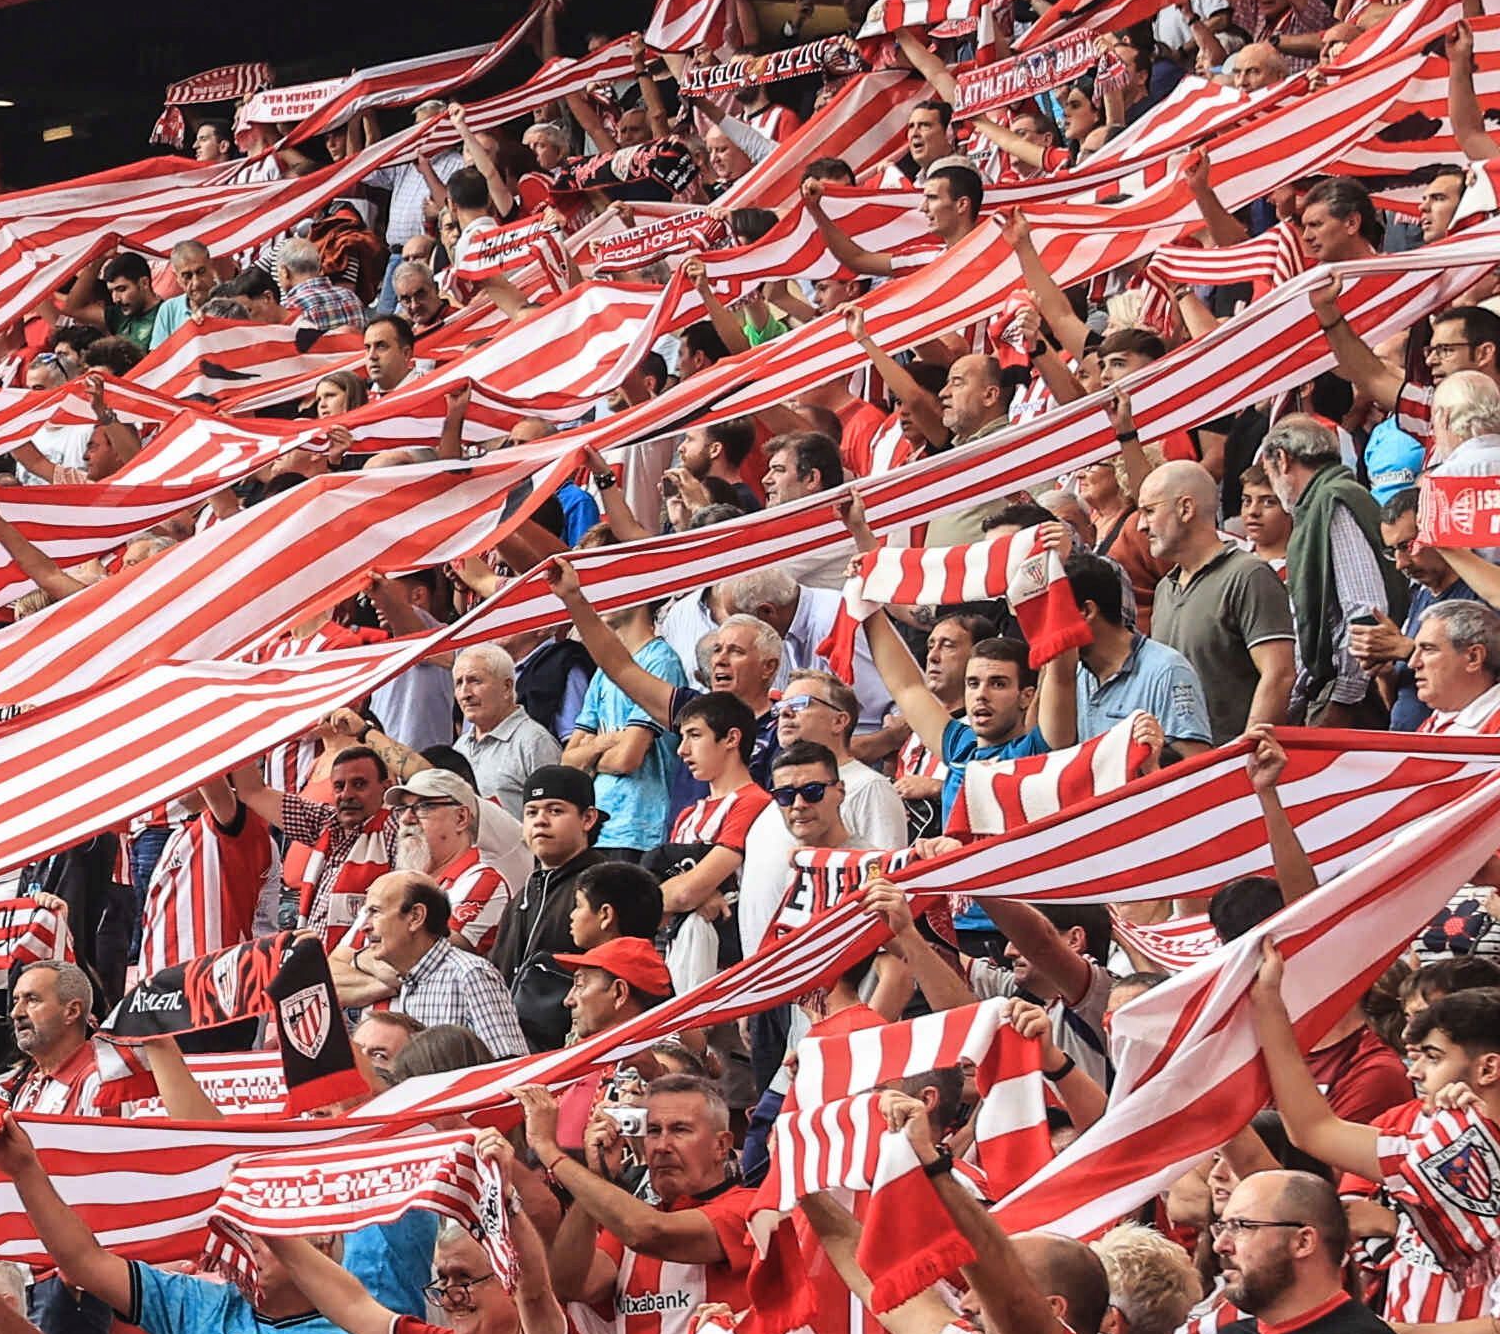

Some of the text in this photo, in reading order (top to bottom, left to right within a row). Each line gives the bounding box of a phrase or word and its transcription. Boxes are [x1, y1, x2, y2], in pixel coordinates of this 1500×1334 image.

[965, 71, 1025, 107] ATHLETIC
[603, 218, 660, 247] ATHLETIC
[128, 985, 183, 1015] ATHLETIC
